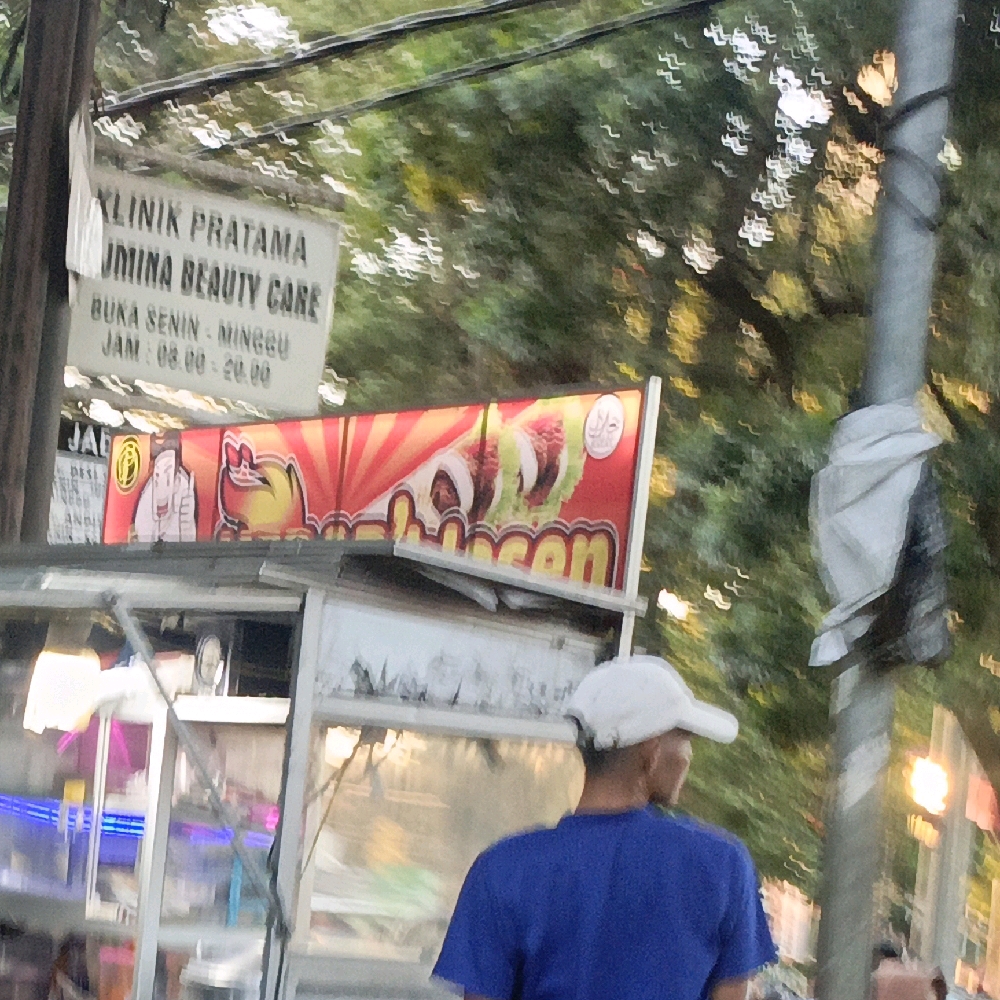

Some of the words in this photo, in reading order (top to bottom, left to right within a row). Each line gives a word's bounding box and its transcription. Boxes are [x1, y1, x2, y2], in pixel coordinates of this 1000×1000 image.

[189, 205, 307, 268] PRATAMA
[101, 236, 172, 293] UMINA
[180, 253, 261, 311] BEAUTY
[267, 273, 322, 324] CARE
[91, 291, 139, 330] BUKA
[145, 303, 200, 341] SENIN
[218, 318, 290, 361] MINGGU
[102, 327, 140, 362] JAM
